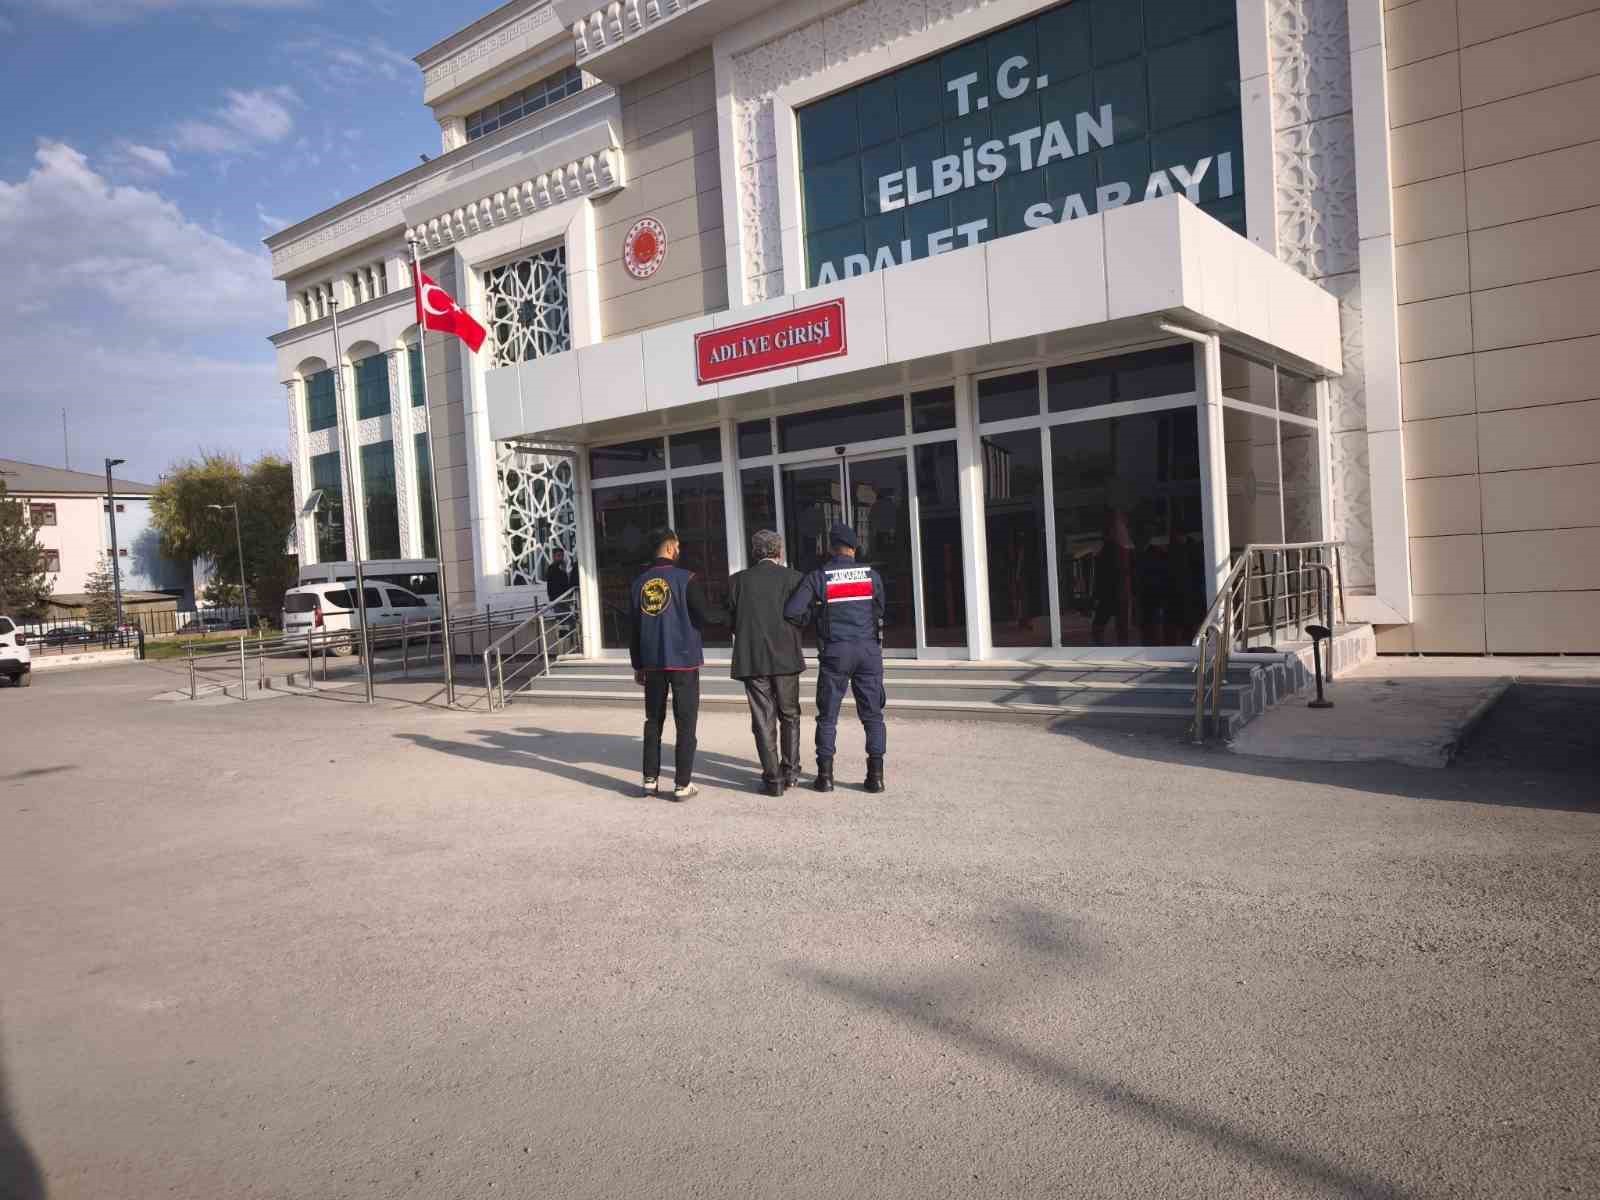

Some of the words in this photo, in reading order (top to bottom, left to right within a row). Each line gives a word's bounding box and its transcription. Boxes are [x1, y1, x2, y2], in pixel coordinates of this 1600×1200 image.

[946, 55, 1049, 117] T.C.
[878, 104, 1114, 214] ELBİSTAN
[709, 335, 770, 364] ADLİYE
[774, 317, 831, 347] GİRİŞİ
